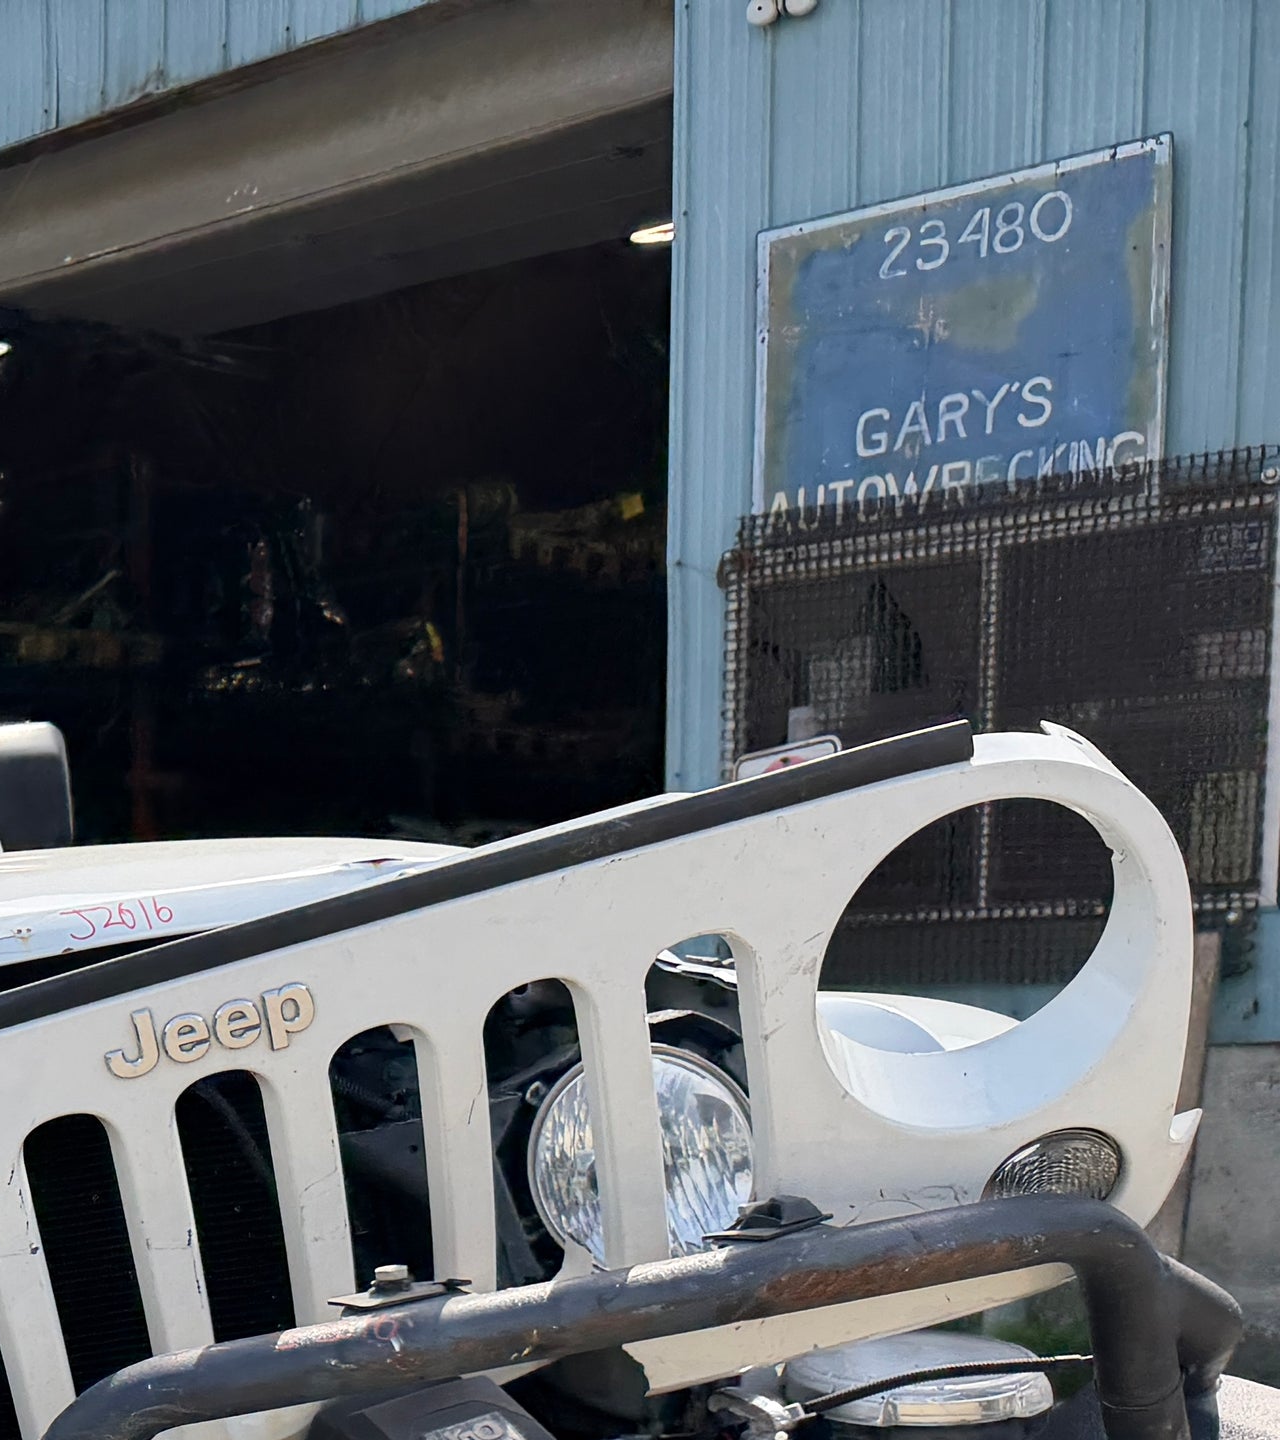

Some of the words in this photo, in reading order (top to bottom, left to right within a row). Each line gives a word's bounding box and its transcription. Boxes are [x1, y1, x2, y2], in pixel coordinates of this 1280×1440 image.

[878, 189, 1073, 280] 23480
[855, 375, 1053, 458] GARY'S
[103, 981, 316, 1080] Jeep
